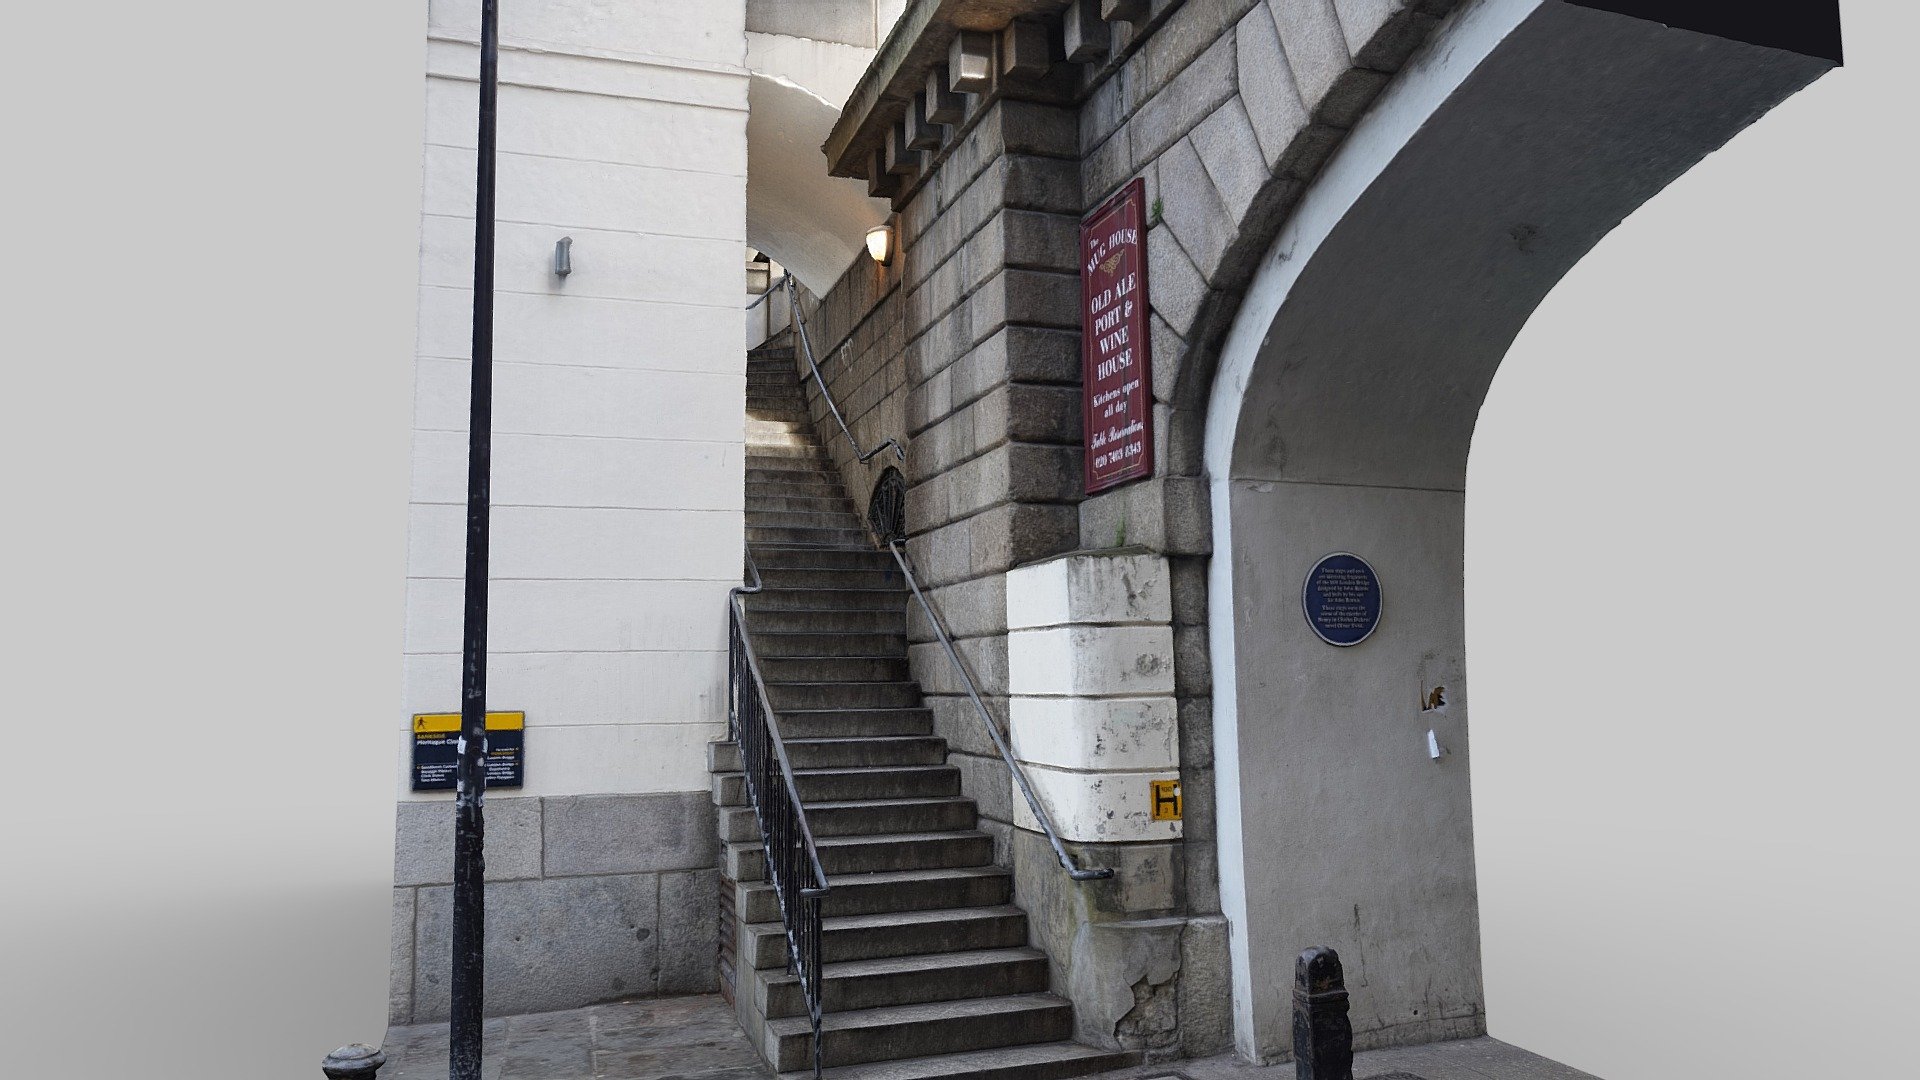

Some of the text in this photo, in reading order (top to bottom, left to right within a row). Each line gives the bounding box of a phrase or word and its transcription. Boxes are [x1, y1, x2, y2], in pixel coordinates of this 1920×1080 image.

[1087, 228, 1138, 275] MUG HOUSE
[1090, 238, 1099, 249] The
[1091, 272, 1136, 315] OLD ALE
[1095, 300, 1133, 336] PORT &
[1100, 325, 1129, 355] WINE
[1098, 348, 1133, 381] HOUSE
[1093, 379, 1139, 408] Kitchens open
[1104, 400, 1127, 418] all day
[1095, 454, 1108, 469] 020
[1156, 784, 1178, 816] H
